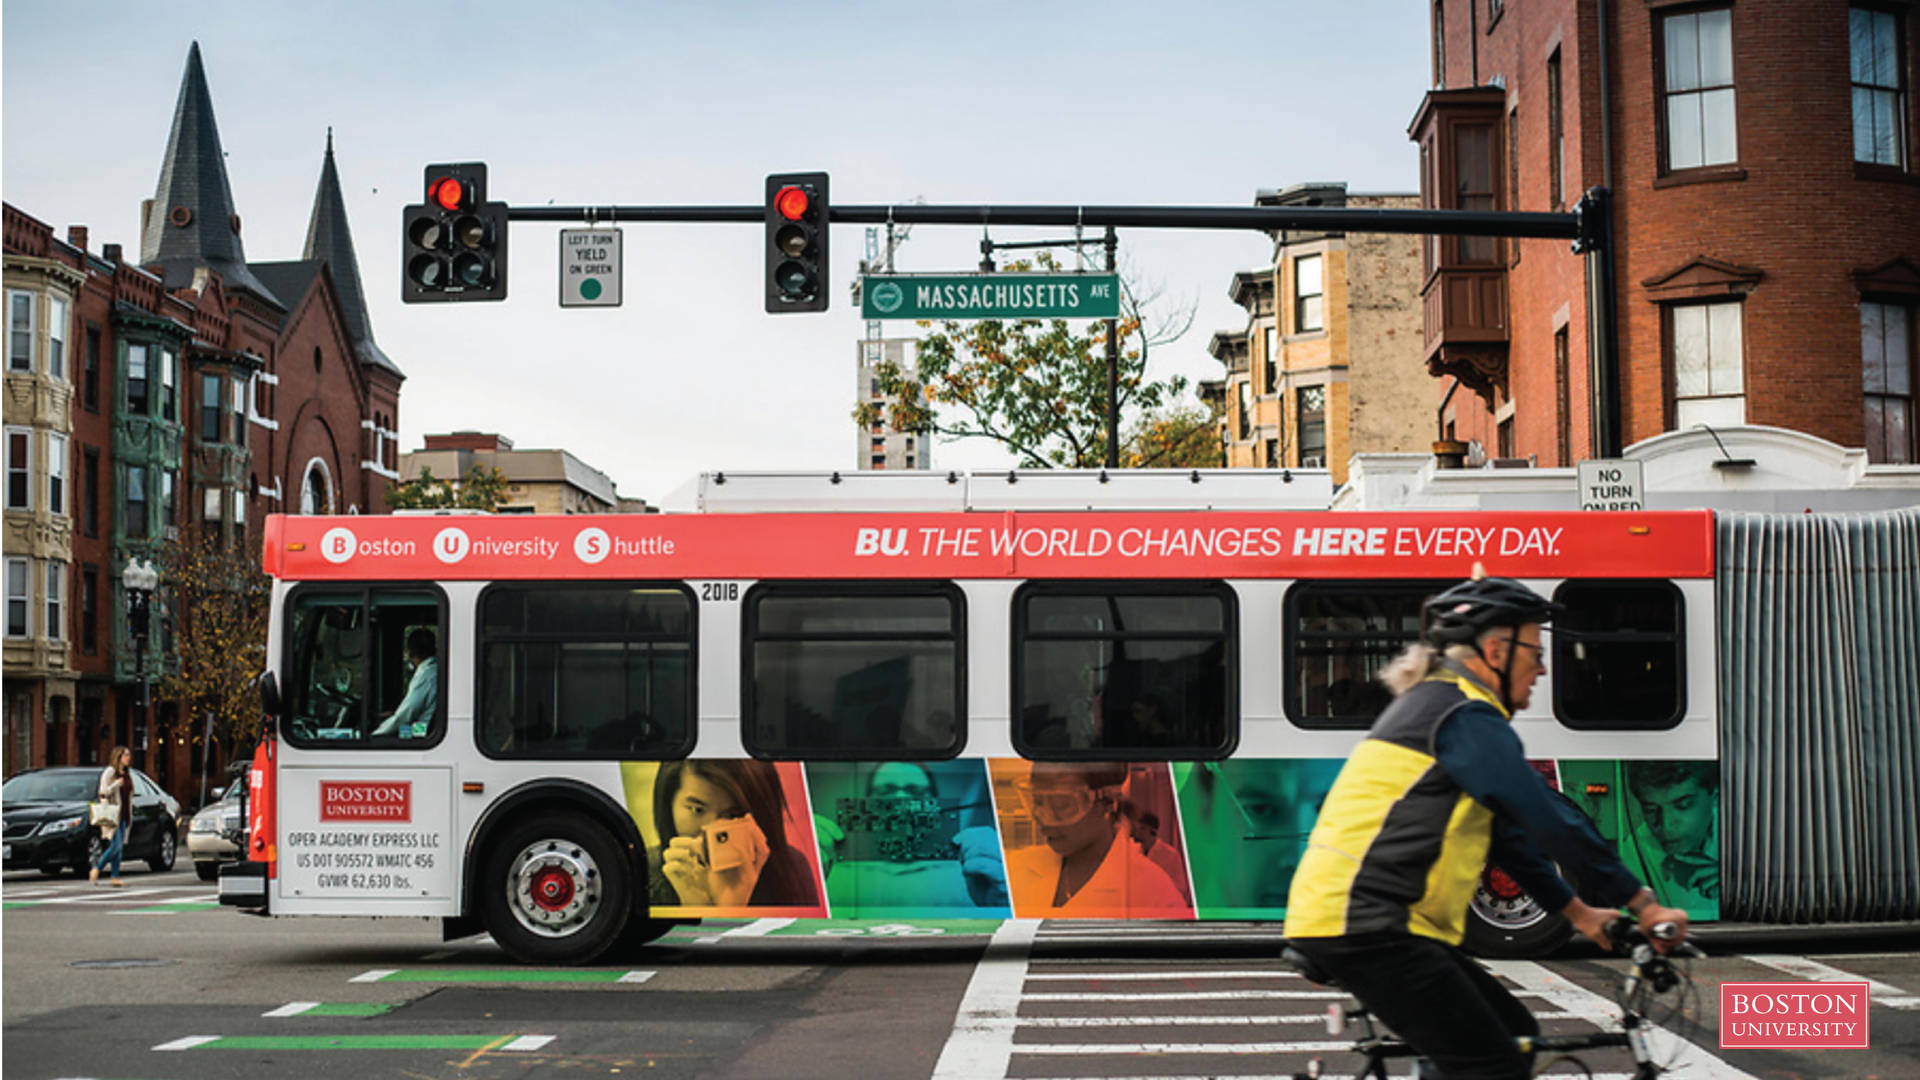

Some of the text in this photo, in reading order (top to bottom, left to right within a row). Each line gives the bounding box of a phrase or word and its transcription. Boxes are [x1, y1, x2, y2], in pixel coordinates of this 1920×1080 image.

[568, 235, 613, 245] LEFT TURN
[576, 248, 607, 261] YIELD
[568, 264, 613, 274] ON GREEN
[916, 284, 1080, 309] MASSACHUSETTS
[1090, 284, 1111, 298] AVE
[1598, 469, 1622, 482] NO
[1591, 485, 1632, 499] TURN
[331, 534, 675, 560] Boston University Shuttle
[855, 527, 1563, 557] BU. THE WORLD CHANGES HERE EVERY DAY.
[702, 583, 738, 601] 2018
[327, 787, 405, 802] BOSTON
[327, 805, 405, 816] UNIVERSITY
[288, 832, 439, 848] OPER ACADEMY EXPRESS LLC
[296, 853, 434, 868] US DOT 905572 WMATC 456
[317, 874, 413, 889] GVWR 62,630 lbs.
